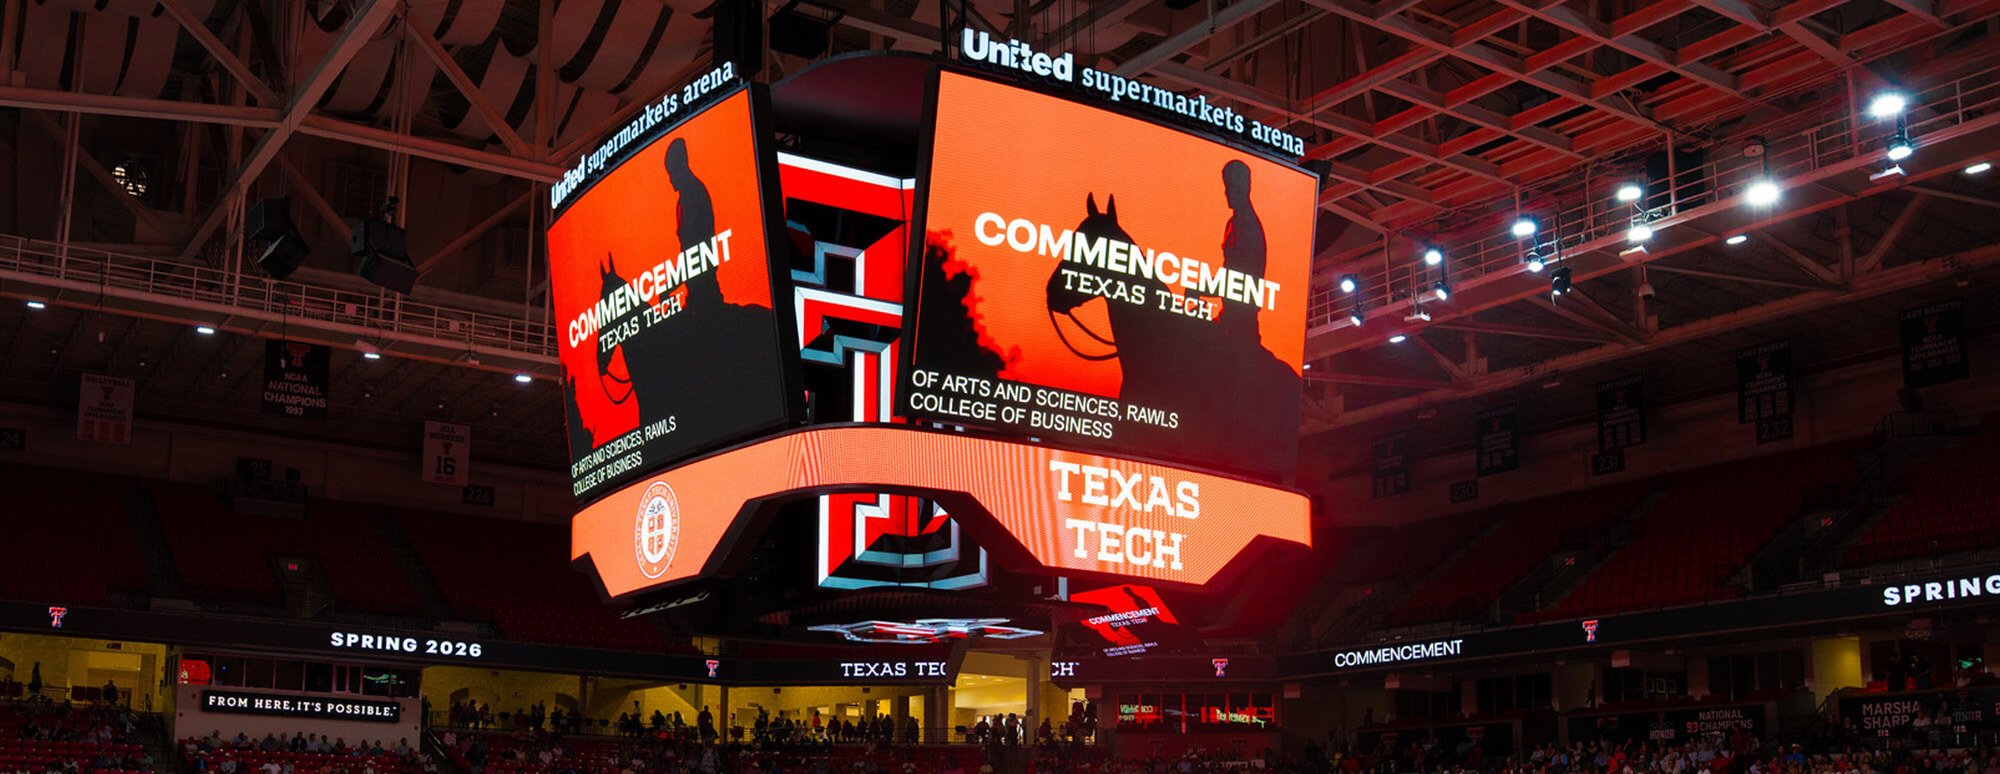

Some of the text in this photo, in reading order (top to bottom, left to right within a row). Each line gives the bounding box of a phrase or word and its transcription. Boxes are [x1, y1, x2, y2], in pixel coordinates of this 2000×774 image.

[963, 27, 1305, 156] United supermarkets arena
[551, 61, 733, 209] United supermarkets arena
[974, 211, 1281, 311] COMMENCEMENT
[568, 229, 732, 348] COMMENCEMENT
[1061, 269, 1214, 321] TEXAS TECH
[599, 293, 683, 353] TEXAS TECH
[269, 380, 321, 396] NATIONAL
[284, 372, 307, 383] NCAA
[263, 391, 327, 408] CHAMPIONS
[912, 369, 1178, 429] OF ARTS AND SCIENCES, RAWLS
[285, 406, 304, 416] 1993
[909, 393, 1113, 439] COLLEGE OF BUSINESS
[440, 425, 456, 433] JILL
[1760, 419, 1790, 440] 232
[571, 415, 677, 478] OF ARTS AND SCIENCES, RAWLS
[435, 456, 455, 475] 16
[574, 451, 642, 496] COLLEGE OF BUSINESS
[466, 488, 490, 502] 226
[1050, 460, 1200, 519] TEXAS
[1065, 518, 1184, 570] TECH
[1883, 574, 2000, 606] SPRING
[1089, 607, 1160, 624] COMMENCEMENT
[330, 632, 482, 657] SPRING 2026
[1334, 639, 1463, 667] COMMENCEMENT
[840, 662, 907, 677] TEXAS
[208, 696, 248, 708] FROM
[297, 701, 322, 712] IT'S
[326, 703, 394, 717] POSSIBLE.
[1698, 708, 1743, 720] NATIONAL
[1862, 700, 1920, 716] MARSHA
[1686, 721, 1699, 734] 93
[1863, 715, 1910, 730] SHARP
